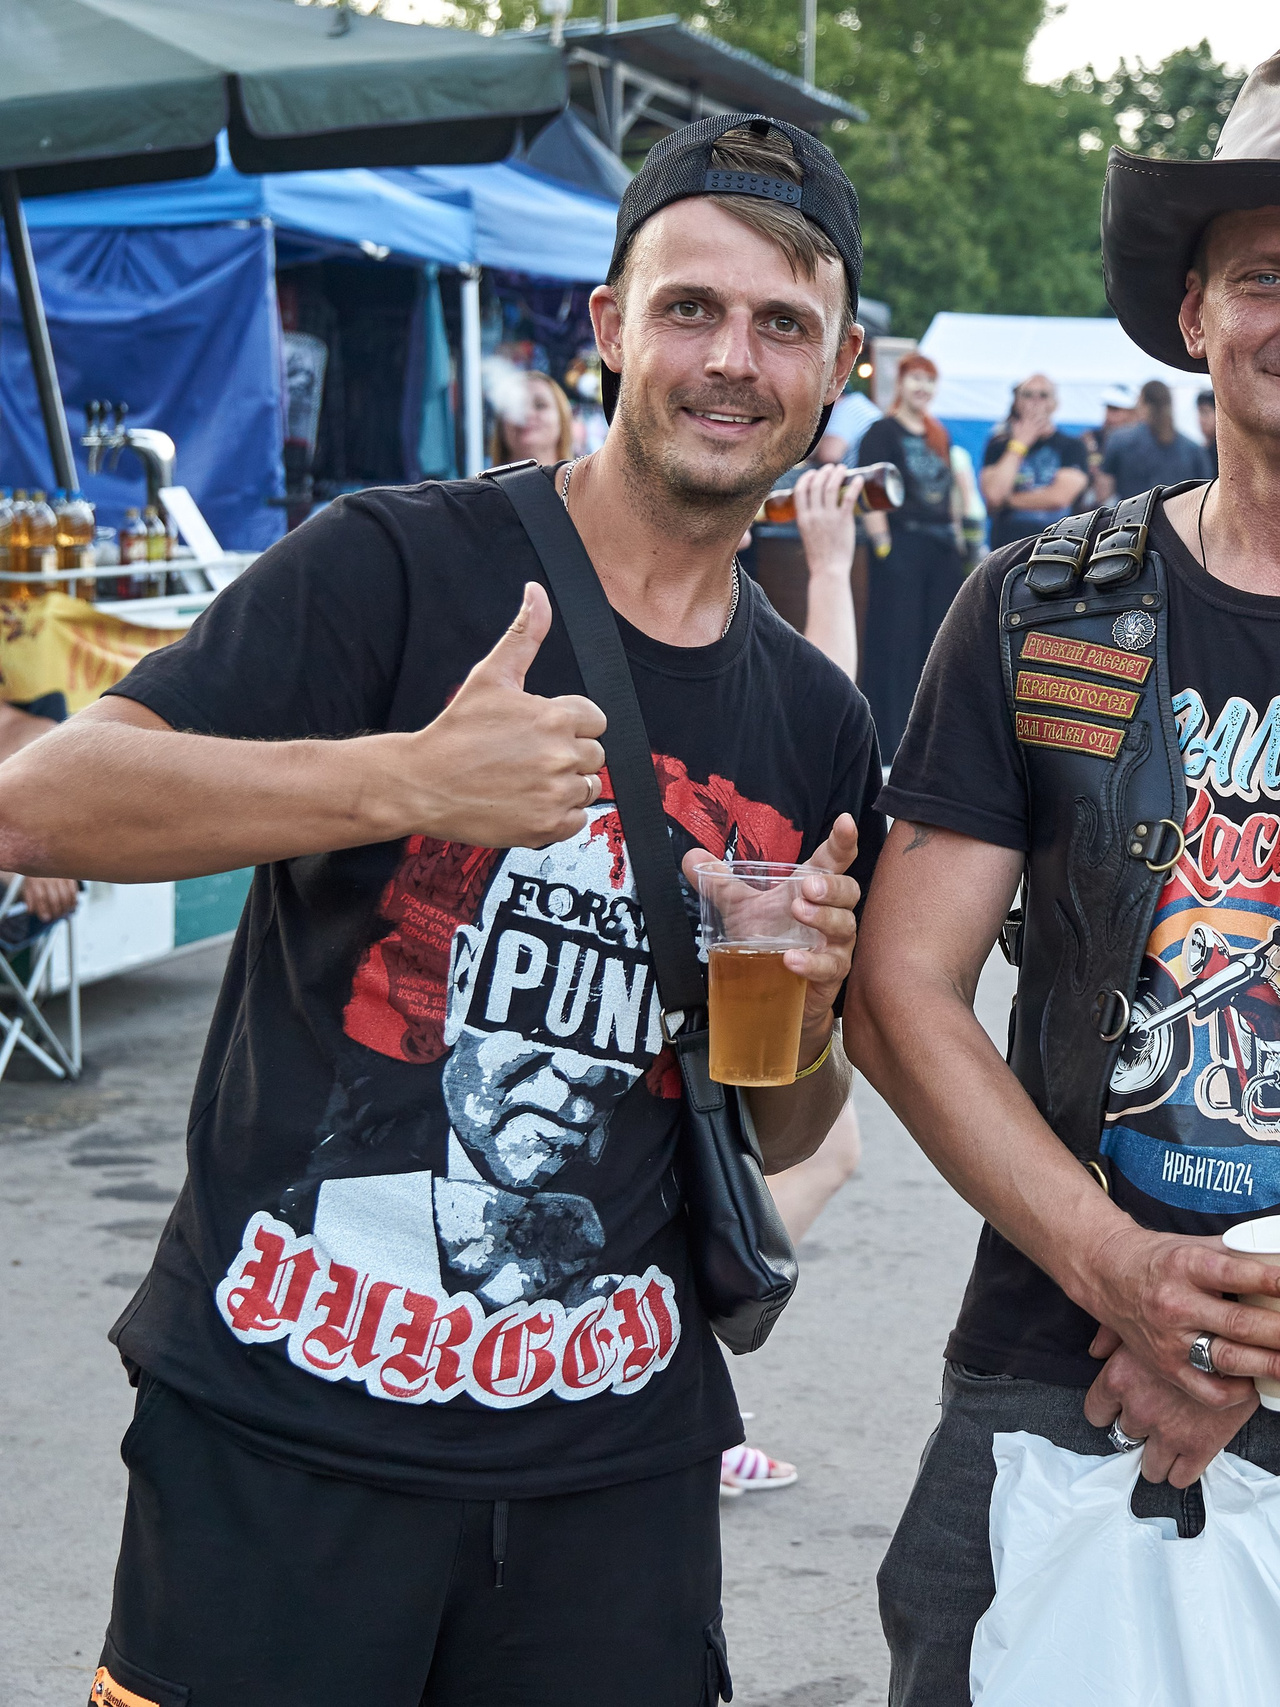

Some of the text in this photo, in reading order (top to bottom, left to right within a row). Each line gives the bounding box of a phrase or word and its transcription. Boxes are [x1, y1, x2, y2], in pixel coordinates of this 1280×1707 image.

[1027, 638, 1146, 676] РУССКИЙ РАССВЕТ
[1019, 677, 1131, 712] КРАСНОГОРСК
[1017, 718, 1040, 738] ЗАМ
[1040, 722, 1086, 745] ГЛАВЫ
